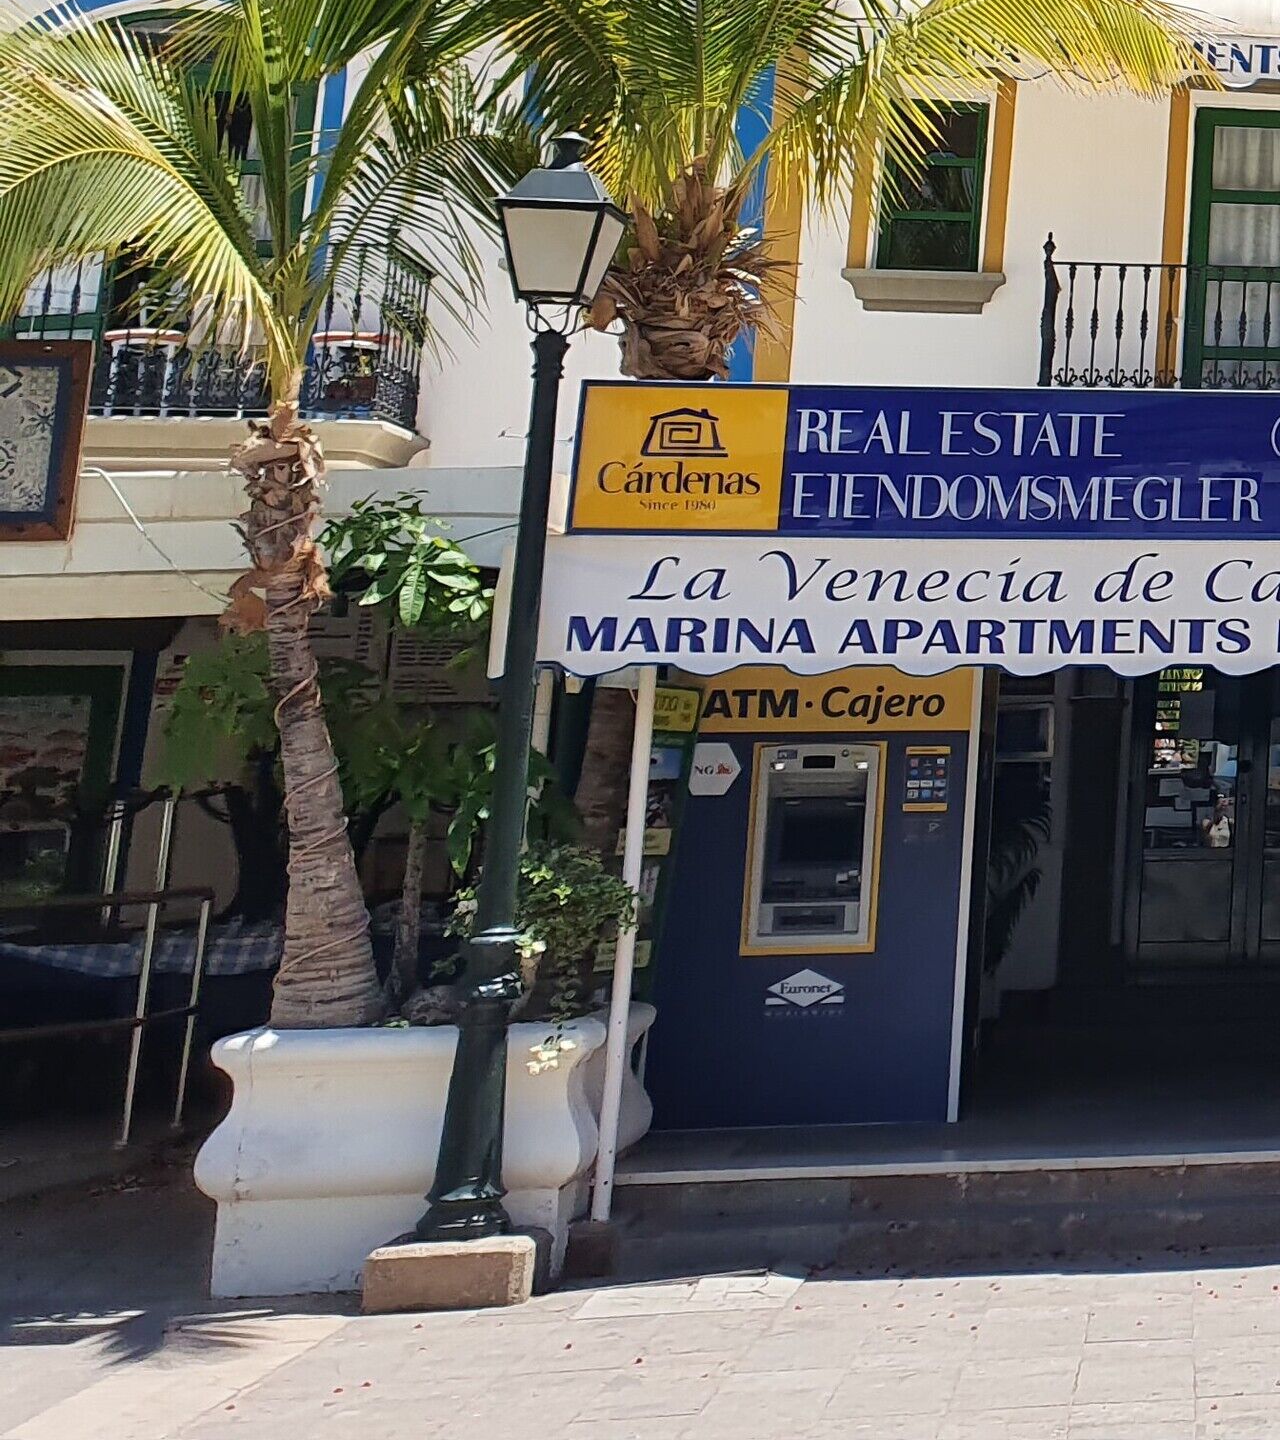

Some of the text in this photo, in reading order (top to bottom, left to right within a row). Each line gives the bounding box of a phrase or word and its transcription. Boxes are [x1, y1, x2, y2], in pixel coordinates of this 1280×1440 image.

[796, 409, 1125, 457] REAL ESTATE
[597, 461, 761, 495] Cárdenas
[791, 473, 1262, 522] EIENDOMSMEGLER
[639, 500, 679, 510] Since
[627, 556, 731, 602] La
[1094, 553, 1174, 603] de
[566, 615, 817, 653] MARINA
[839, 617, 1251, 655] APARTMENTS
[702, 689, 799, 718] ATM
[821, 686, 946, 725] Cajero
[780, 982, 832, 995] Euronet
